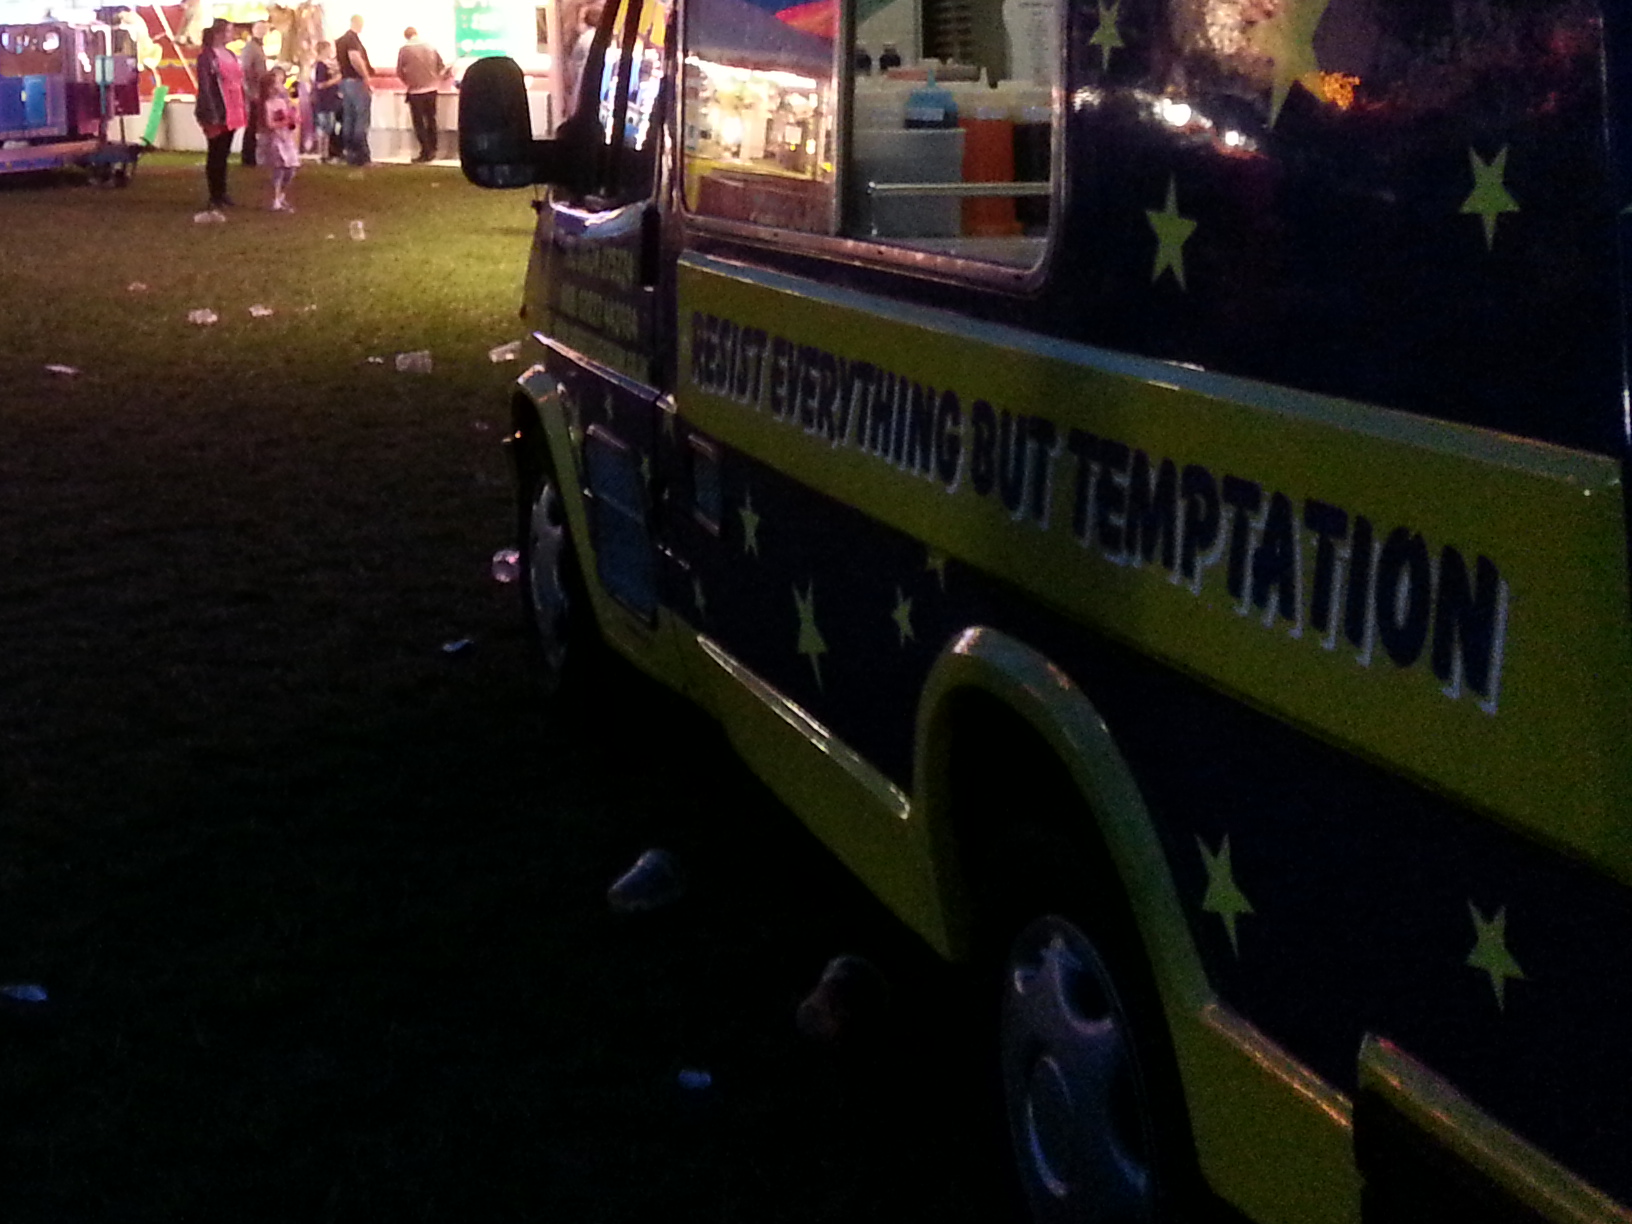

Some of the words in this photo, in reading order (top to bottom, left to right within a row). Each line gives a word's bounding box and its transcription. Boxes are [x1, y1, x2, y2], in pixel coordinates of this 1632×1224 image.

[691, 310, 770, 412] RESIST
[771, 335, 965, 495] EVERYTHING
[972, 398, 1063, 530] BUT
[1069, 428, 1510, 716] TEMPTATION
